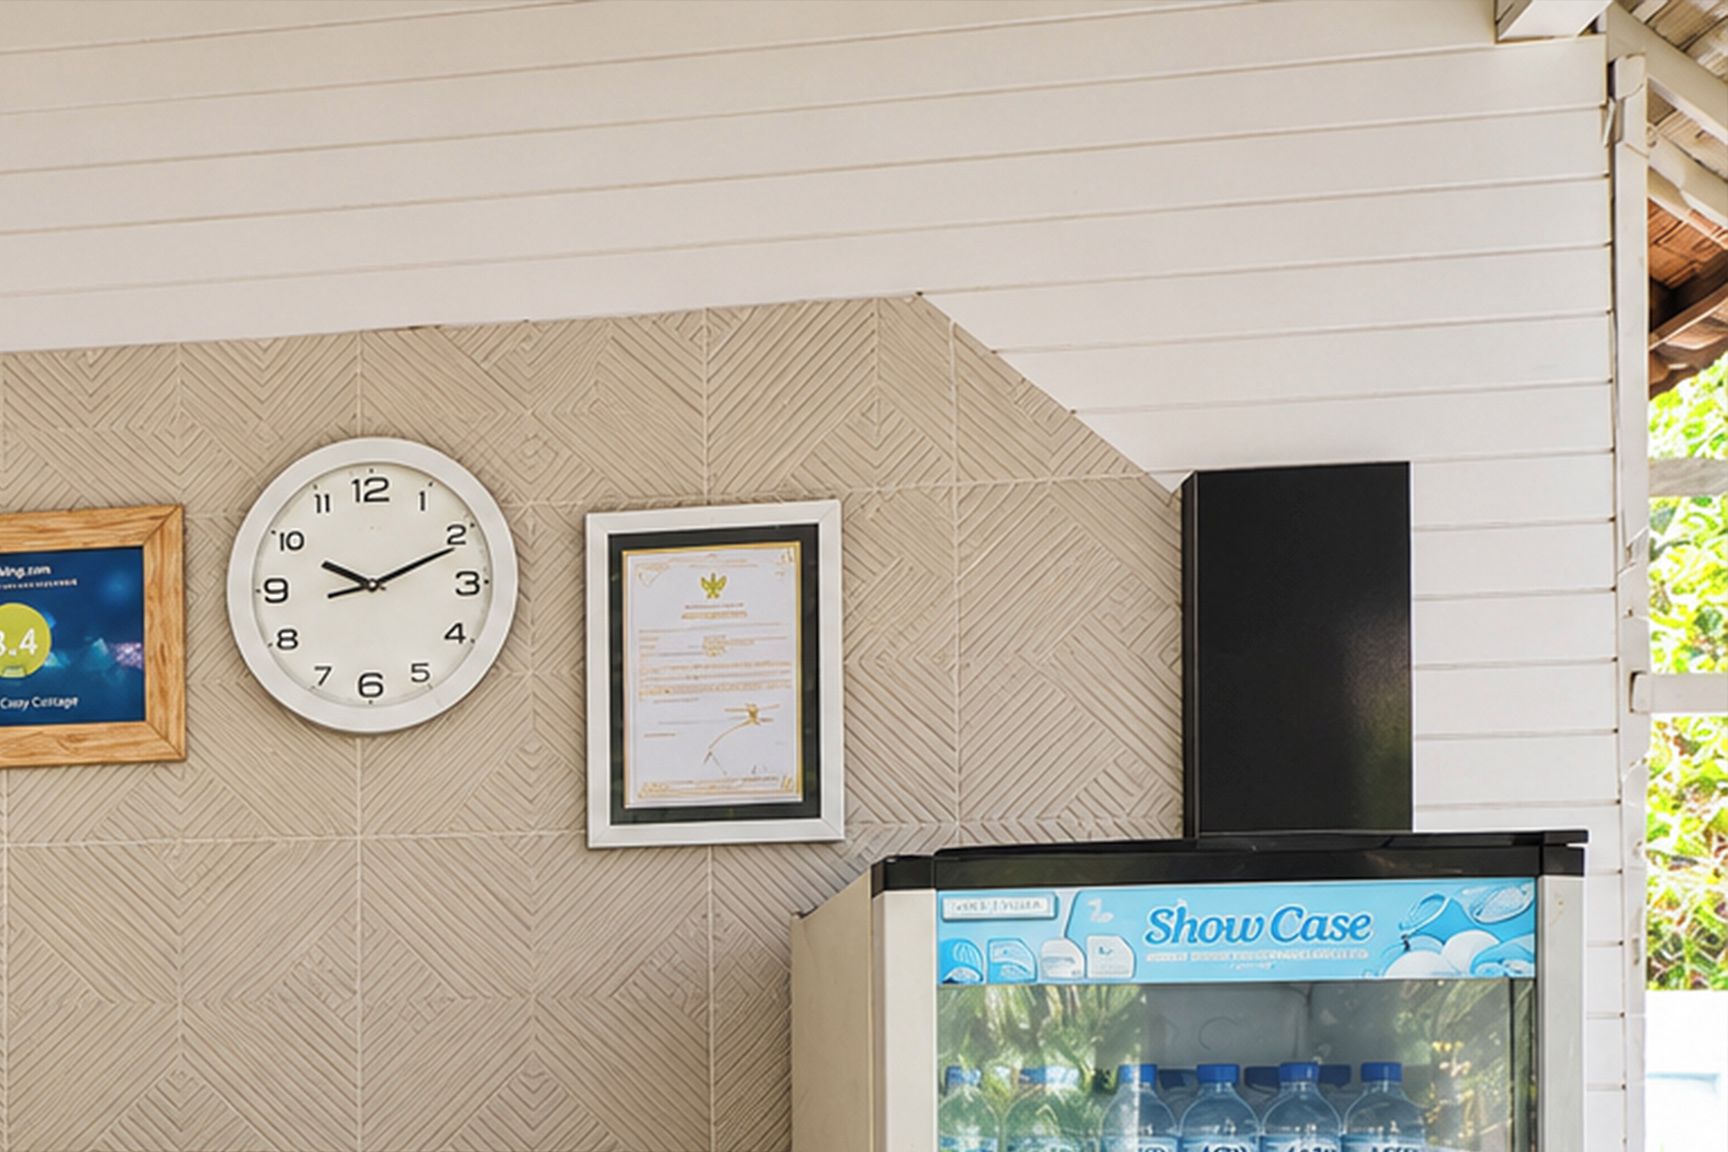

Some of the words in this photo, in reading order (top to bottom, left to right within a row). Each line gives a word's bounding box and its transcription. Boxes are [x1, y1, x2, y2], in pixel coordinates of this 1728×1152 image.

[351, 477, 390, 503] 12
[418, 490, 426, 512] 1
[314, 493, 331, 514] 11
[279, 531, 305, 551] 10
[446, 523, 468, 546] 2
[263, 577, 290, 604] 9
[455, 571, 481, 597] 3
[276, 628, 299, 651] 8
[444, 622, 466, 644] 4
[314, 665, 332, 686] 7
[410, 662, 431, 683] 5
[357, 672, 384, 699] 6
[1143, 905, 1266, 945] Show
[1270, 904, 1373, 944] Case
